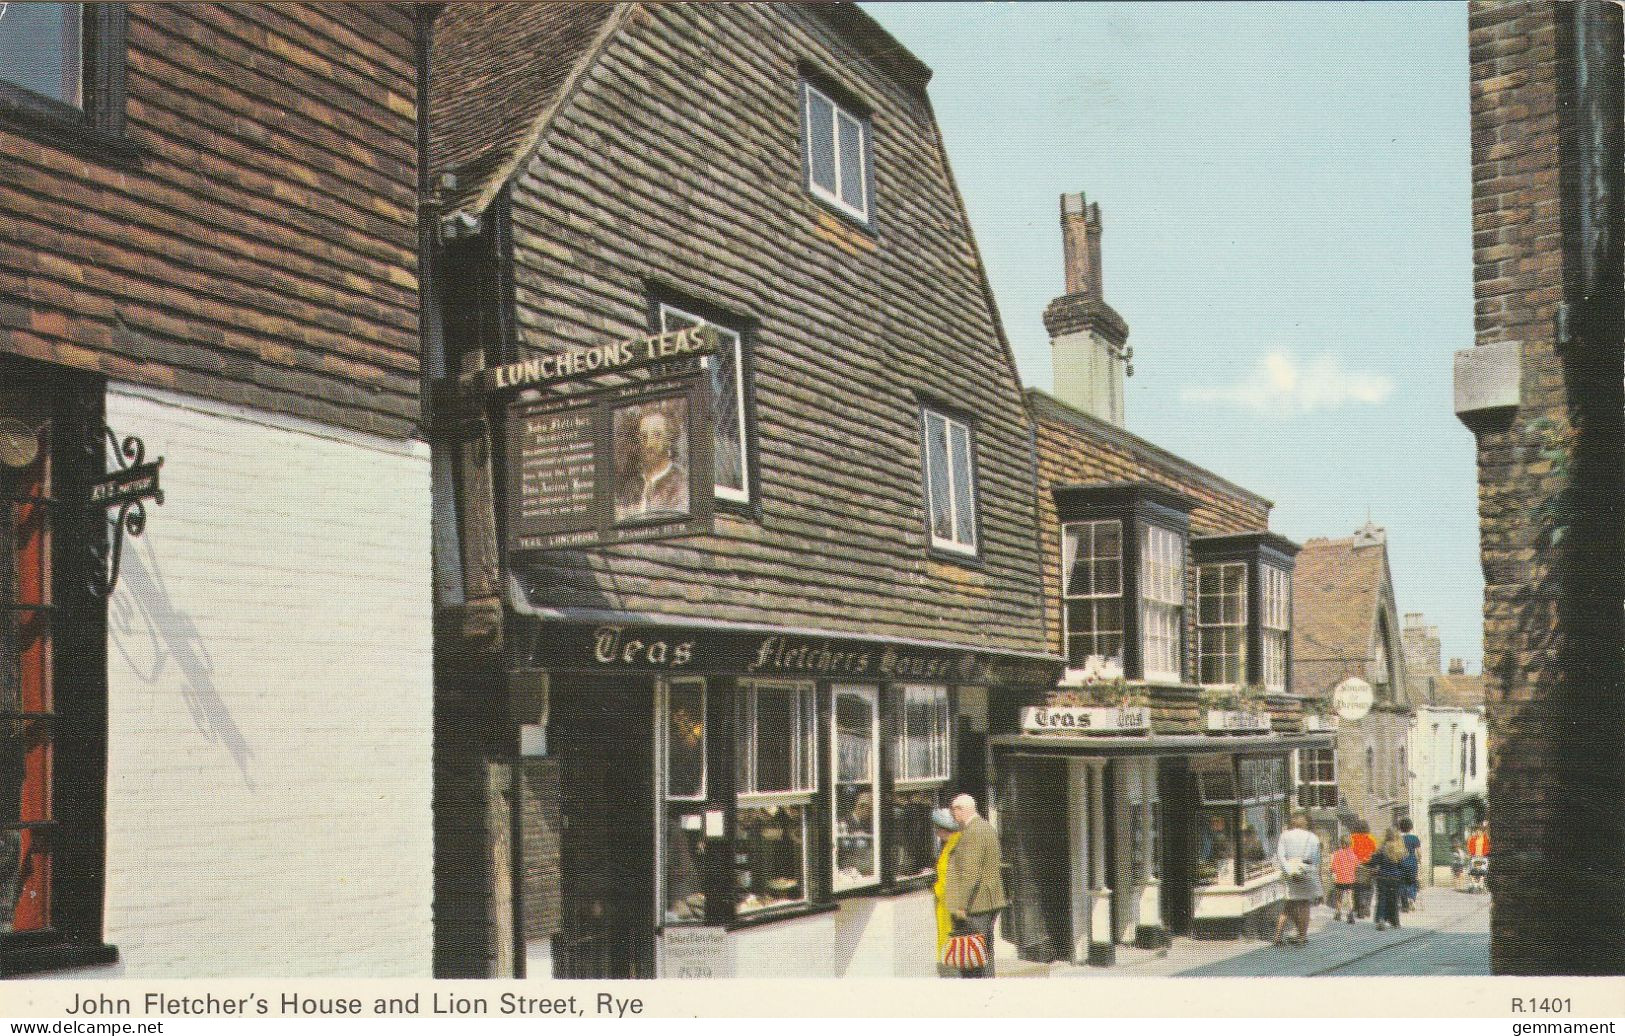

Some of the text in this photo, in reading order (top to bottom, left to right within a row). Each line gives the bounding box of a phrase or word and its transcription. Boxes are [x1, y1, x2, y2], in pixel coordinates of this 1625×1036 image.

[496, 342, 633, 388] LUNCHEONS
[648, 325, 705, 359] TEAS
[595, 625, 695, 666] Teas
[1035, 708, 1092, 727] Teas
